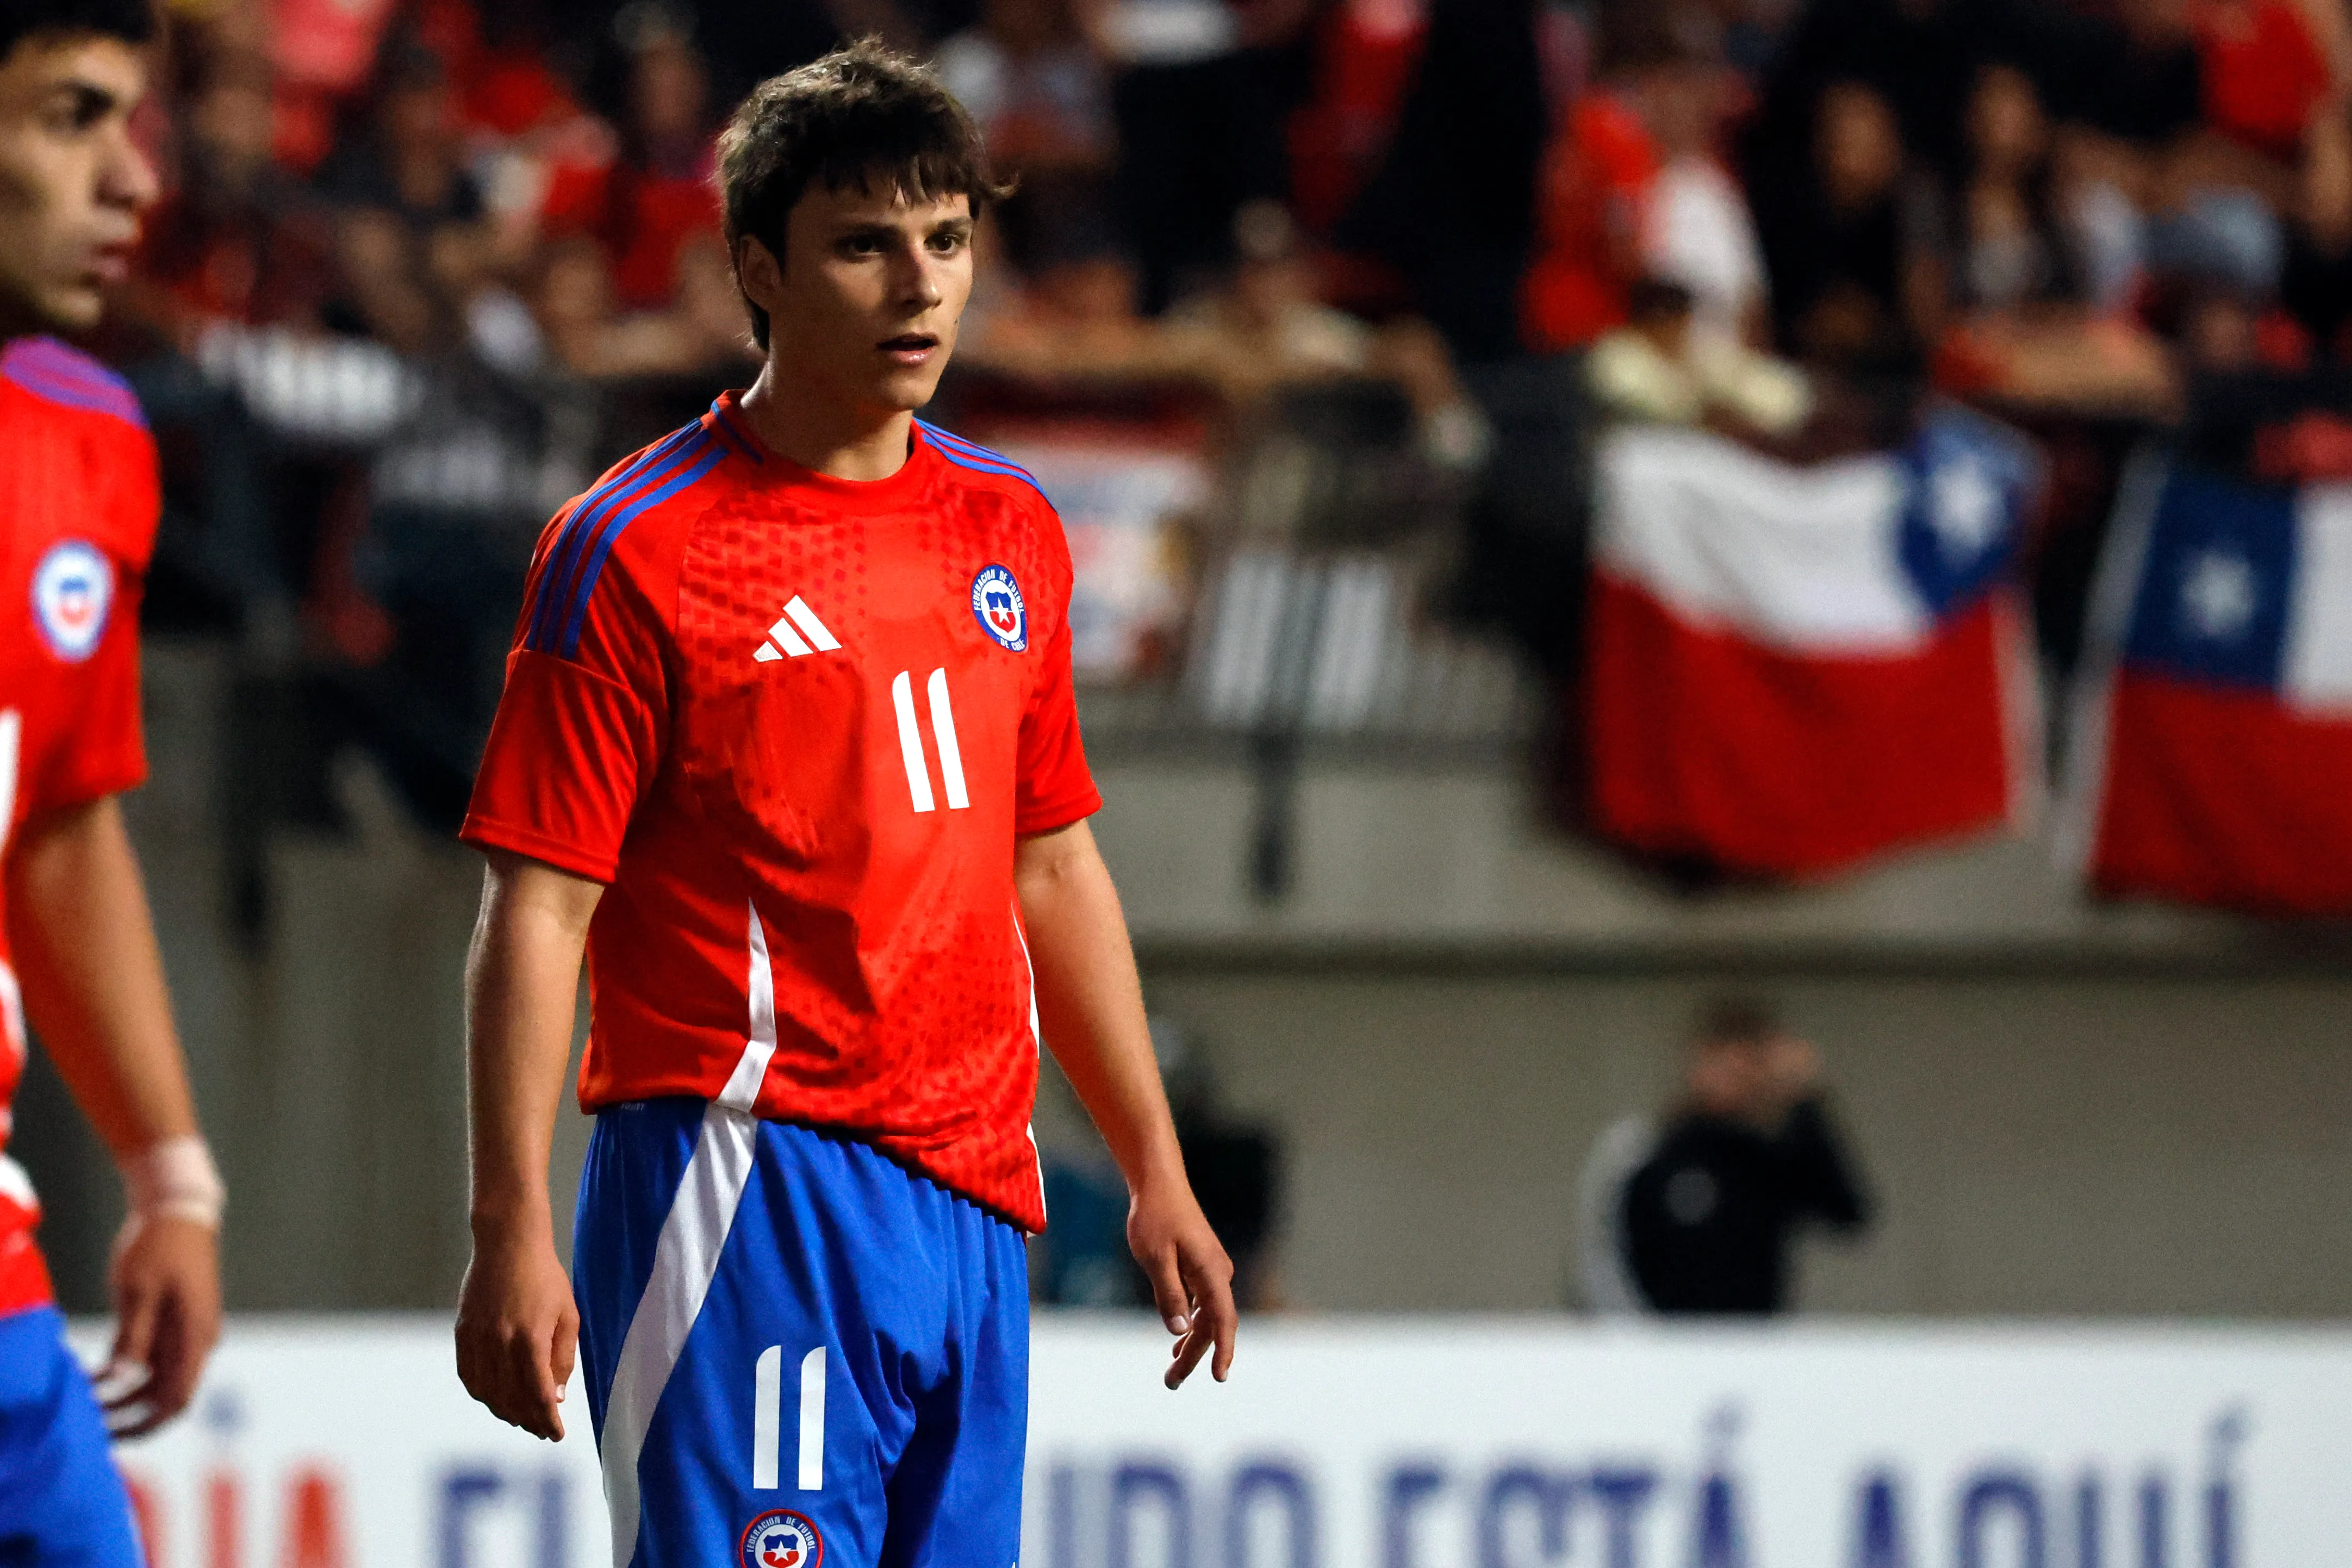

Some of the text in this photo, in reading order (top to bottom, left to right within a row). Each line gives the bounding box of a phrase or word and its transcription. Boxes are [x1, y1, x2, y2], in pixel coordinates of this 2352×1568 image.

[973, 569, 1024, 614] FEDERACION DE FUTBOL
[1000, 638, 1009, 649] DE
[892, 668, 969, 812] 11
[754, 1345, 826, 1490] 11
[746, 1516, 815, 1552] FEDERACION DE FUTBOL
